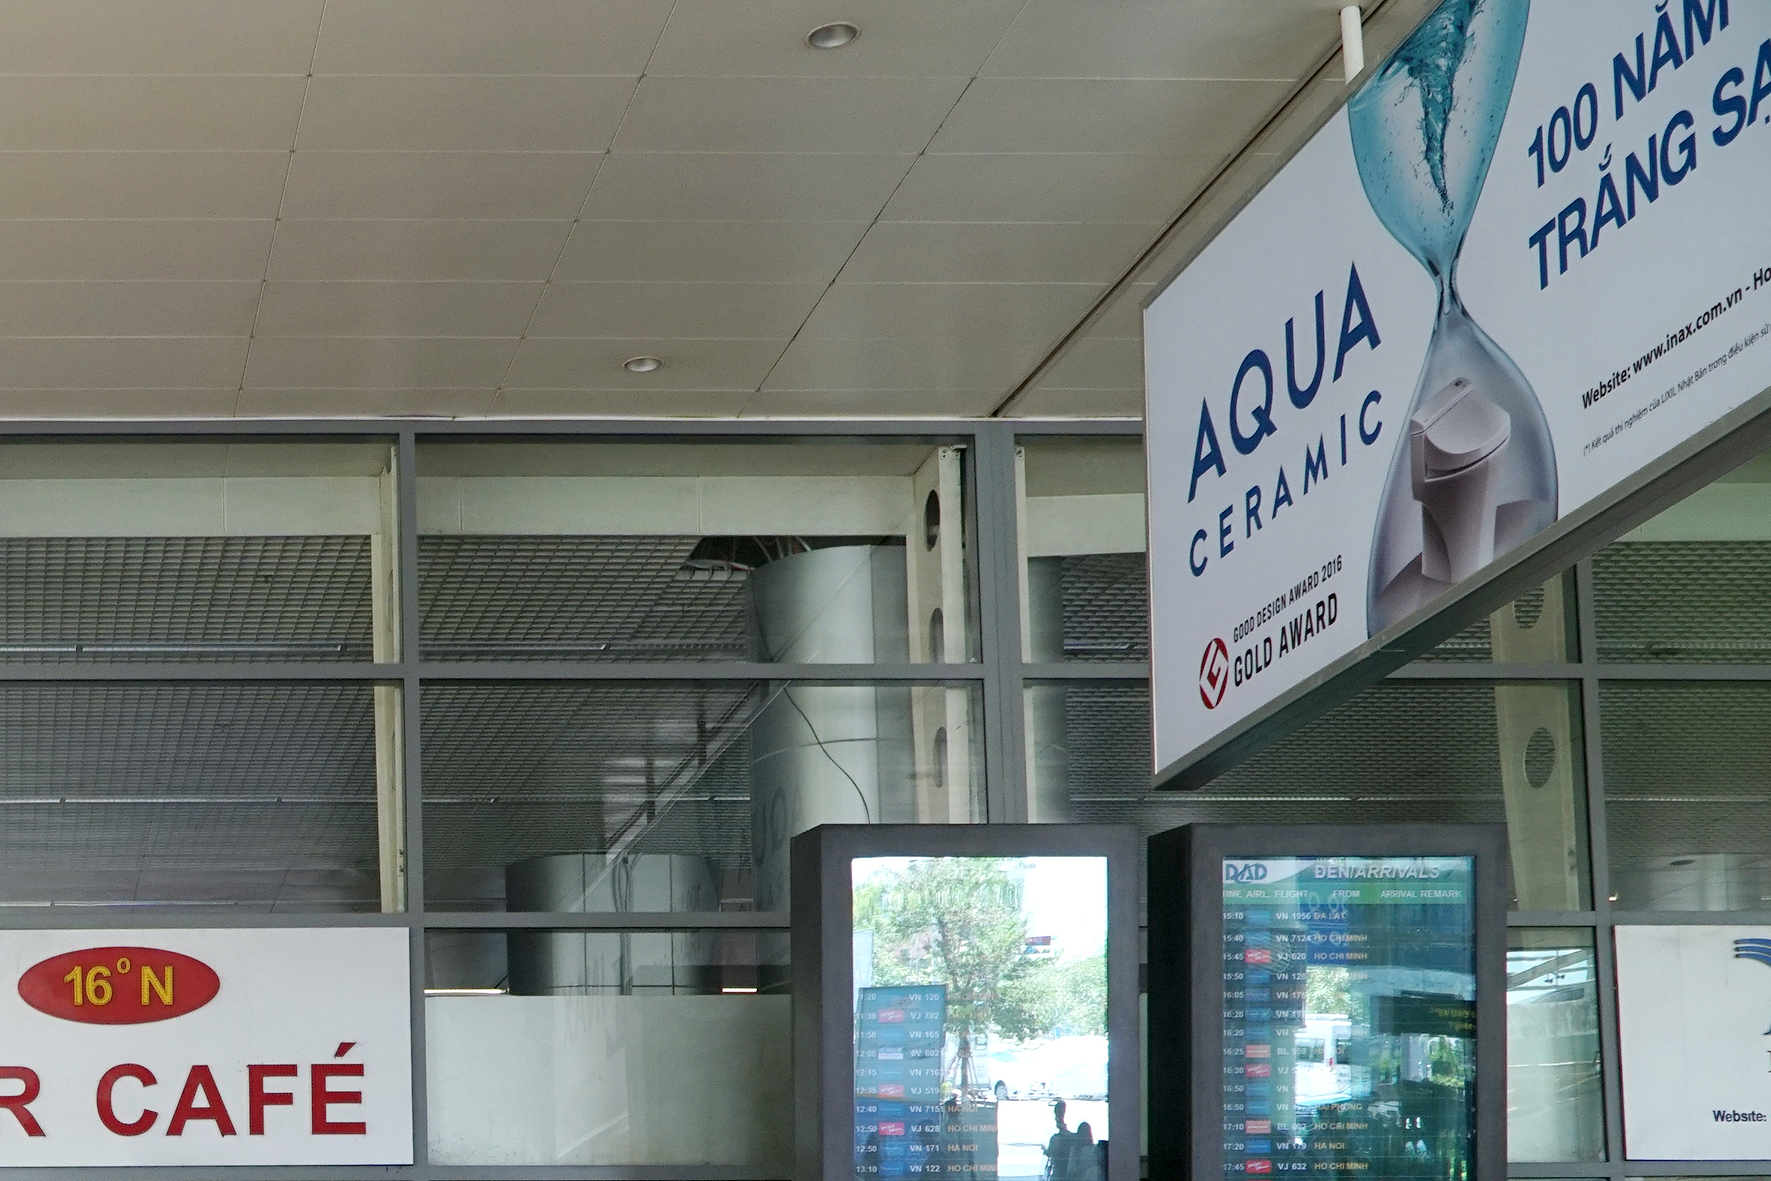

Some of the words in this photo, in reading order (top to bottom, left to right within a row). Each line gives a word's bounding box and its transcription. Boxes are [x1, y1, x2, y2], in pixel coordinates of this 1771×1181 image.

[1528, 82, 1598, 188] 100
[1613, 0, 1729, 122] NĂM
[1528, 110, 1697, 290] TRẮNG
[1187, 261, 1381, 503] AQUA
[1581, 367, 1631, 410] Website:
[1632, 287, 1743, 375] www.inax.com.vn
[1624, 406, 1648, 429] nghiệm
[1708, 353, 1727, 372] trong
[1189, 390, 1383, 577] CERAMIC
[1233, 616, 1255, 643] GOOD
[1256, 592, 1287, 627] DESIGN
[1288, 571, 1319, 605] AWARD
[1321, 554, 1343, 583] 2016
[1234, 636, 1273, 687] GOLD
[1278, 592, 1338, 659] AWARD
[1274, 890, 1309, 898] FLIGHT
[1333, 890, 1360, 898] FROM
[1380, 890, 1417, 898] ARRIVAL
[1420, 890, 1462, 898] REMARK
[141, 964, 174, 1006] N
[95, 1041, 367, 1137] CAFÉ
[1712, 1109, 1767, 1123] Website:
